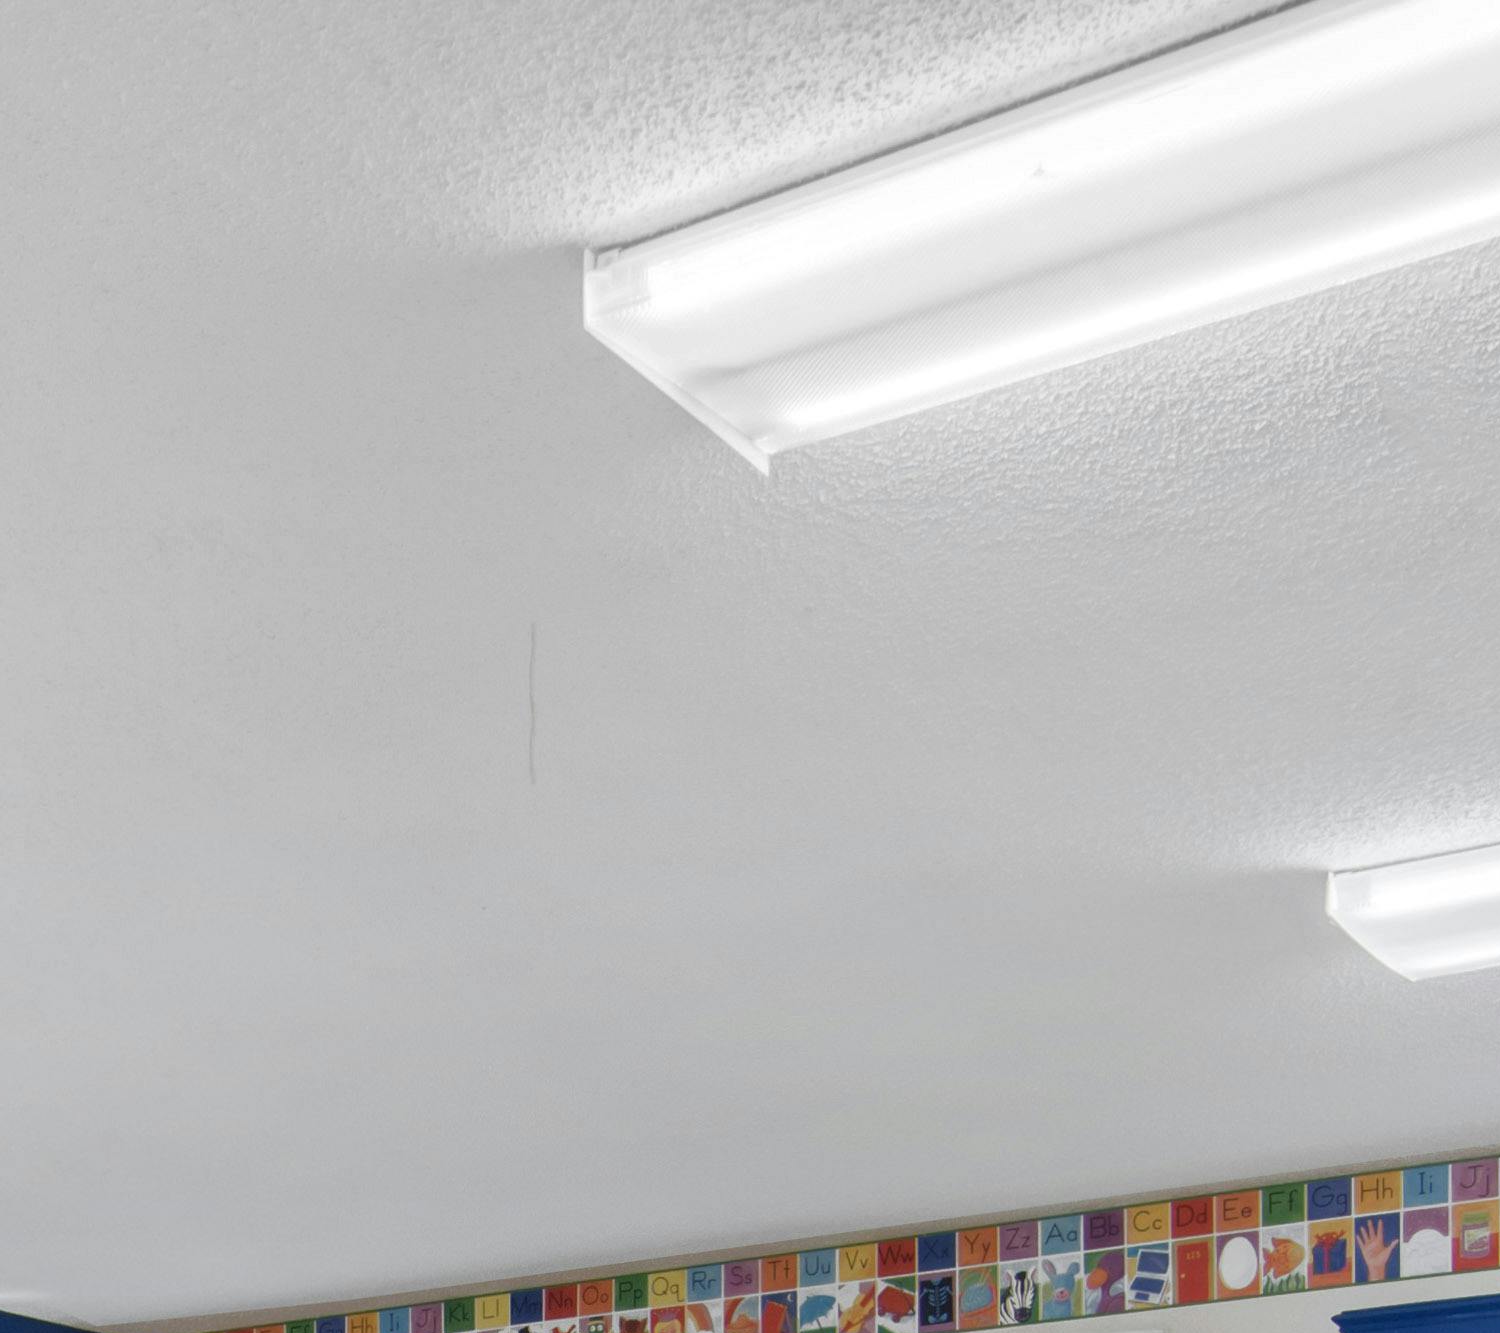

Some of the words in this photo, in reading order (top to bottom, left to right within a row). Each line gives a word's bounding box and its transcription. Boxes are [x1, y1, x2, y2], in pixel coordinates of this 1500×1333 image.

[387, 1311, 401, 1333] Ii
[449, 1304, 471, 1323] Kk
[482, 1299, 501, 1320] Ll
[548, 1290, 575, 1312] Nn
[583, 1285, 609, 1306] Oo
[618, 1283, 643, 1307] Pp
[651, 1276, 684, 1302] Qq
[692, 1270, 717, 1293] Rr
[730, 1266, 754, 1287] Ss
[768, 1261, 790, 1280] Tt
[805, 1254, 831, 1277] Uu
[844, 1251, 869, 1271] Vv
[878, 1242, 912, 1268] Ww
[964, 1235, 992, 1261] Yy
[1005, 1228, 1032, 1253] Zz
[1045, 1222, 1078, 1245] Aa
[1133, 1211, 1163, 1233] Cc
[1175, 1202, 1208, 1229] Dd
[1222, 1197, 1252, 1219] Ee
[1269, 1189, 1297, 1213] Ff
[1313, 1184, 1349, 1215] Gg
[1359, 1177, 1394, 1203] Hh
[1419, 1172, 1434, 1195] Ii
[1459, 1165, 1492, 1197] Jj
